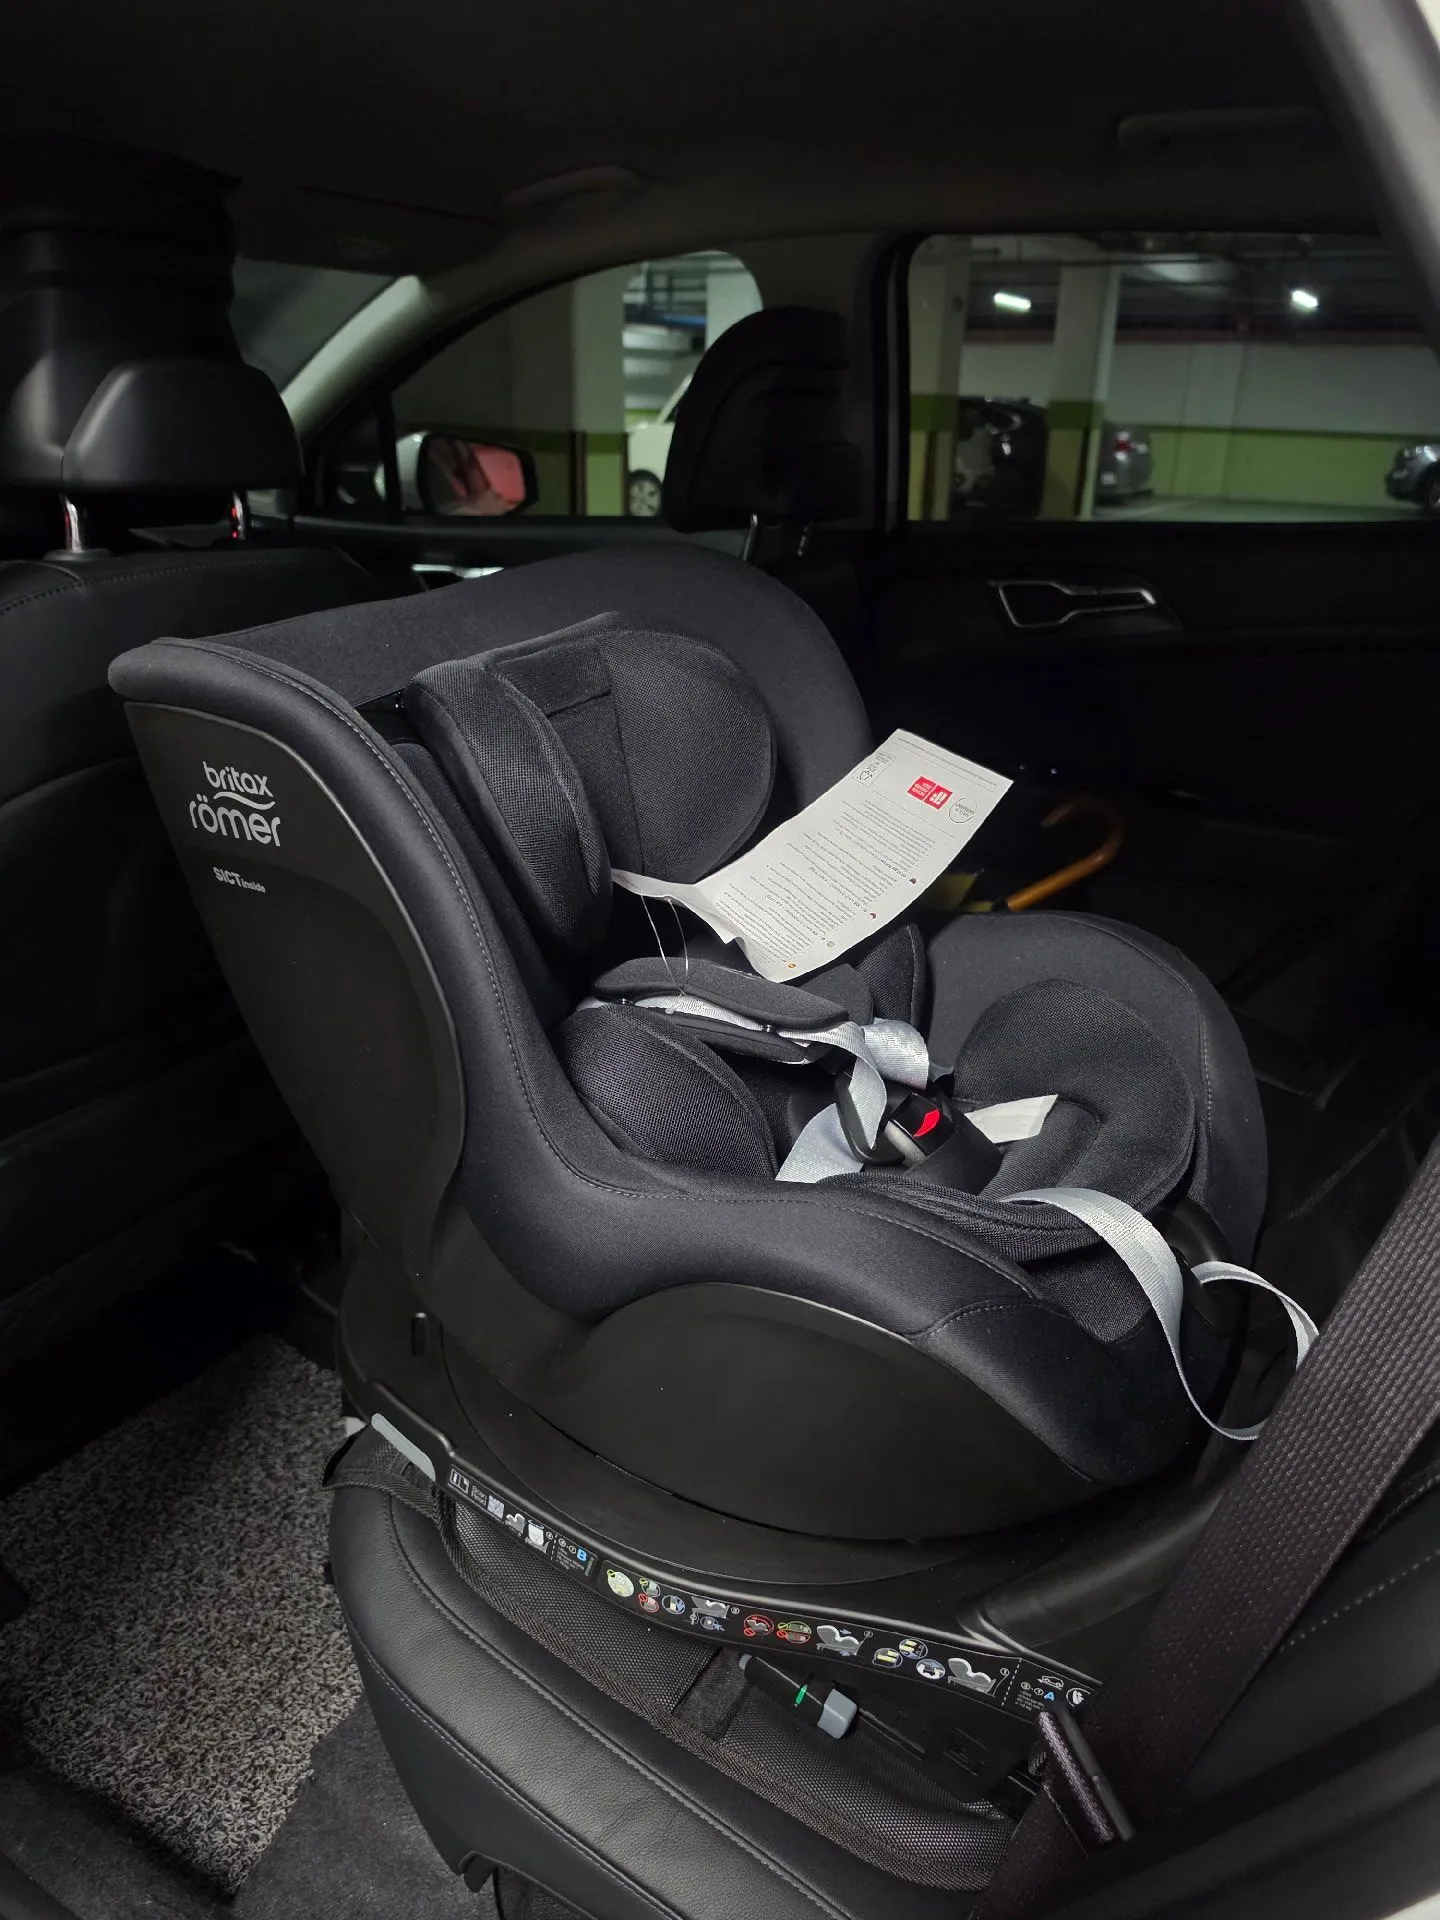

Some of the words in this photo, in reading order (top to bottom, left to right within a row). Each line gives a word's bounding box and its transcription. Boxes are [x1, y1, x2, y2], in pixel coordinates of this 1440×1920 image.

[202, 760, 274, 798] britax
[189, 793, 281, 847] römer
[213, 866, 242, 887] SICT
